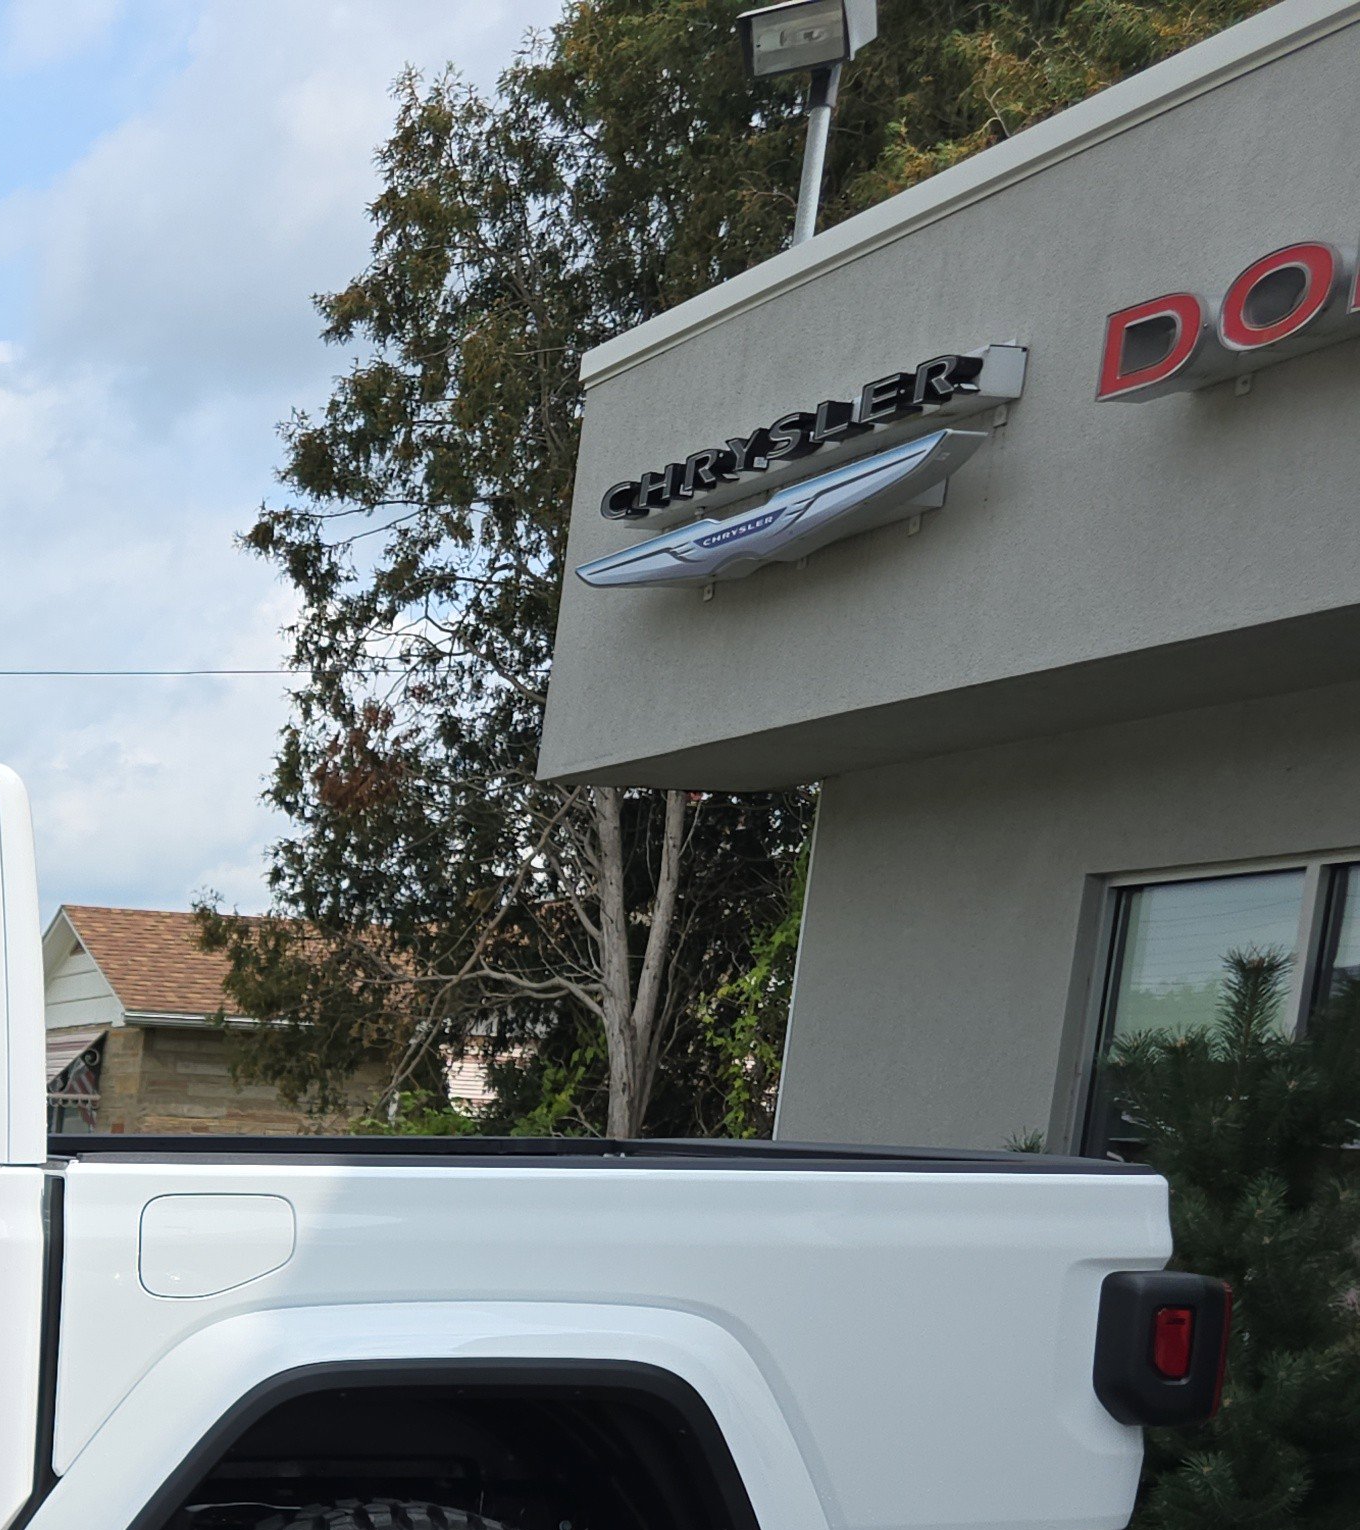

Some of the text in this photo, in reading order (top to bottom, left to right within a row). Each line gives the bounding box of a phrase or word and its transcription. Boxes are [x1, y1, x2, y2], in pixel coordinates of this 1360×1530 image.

[1095, 234, 1360, 400] DO
[600, 354, 980, 521] CHRYSLER
[702, 515, 774, 547] CHRYSLER
